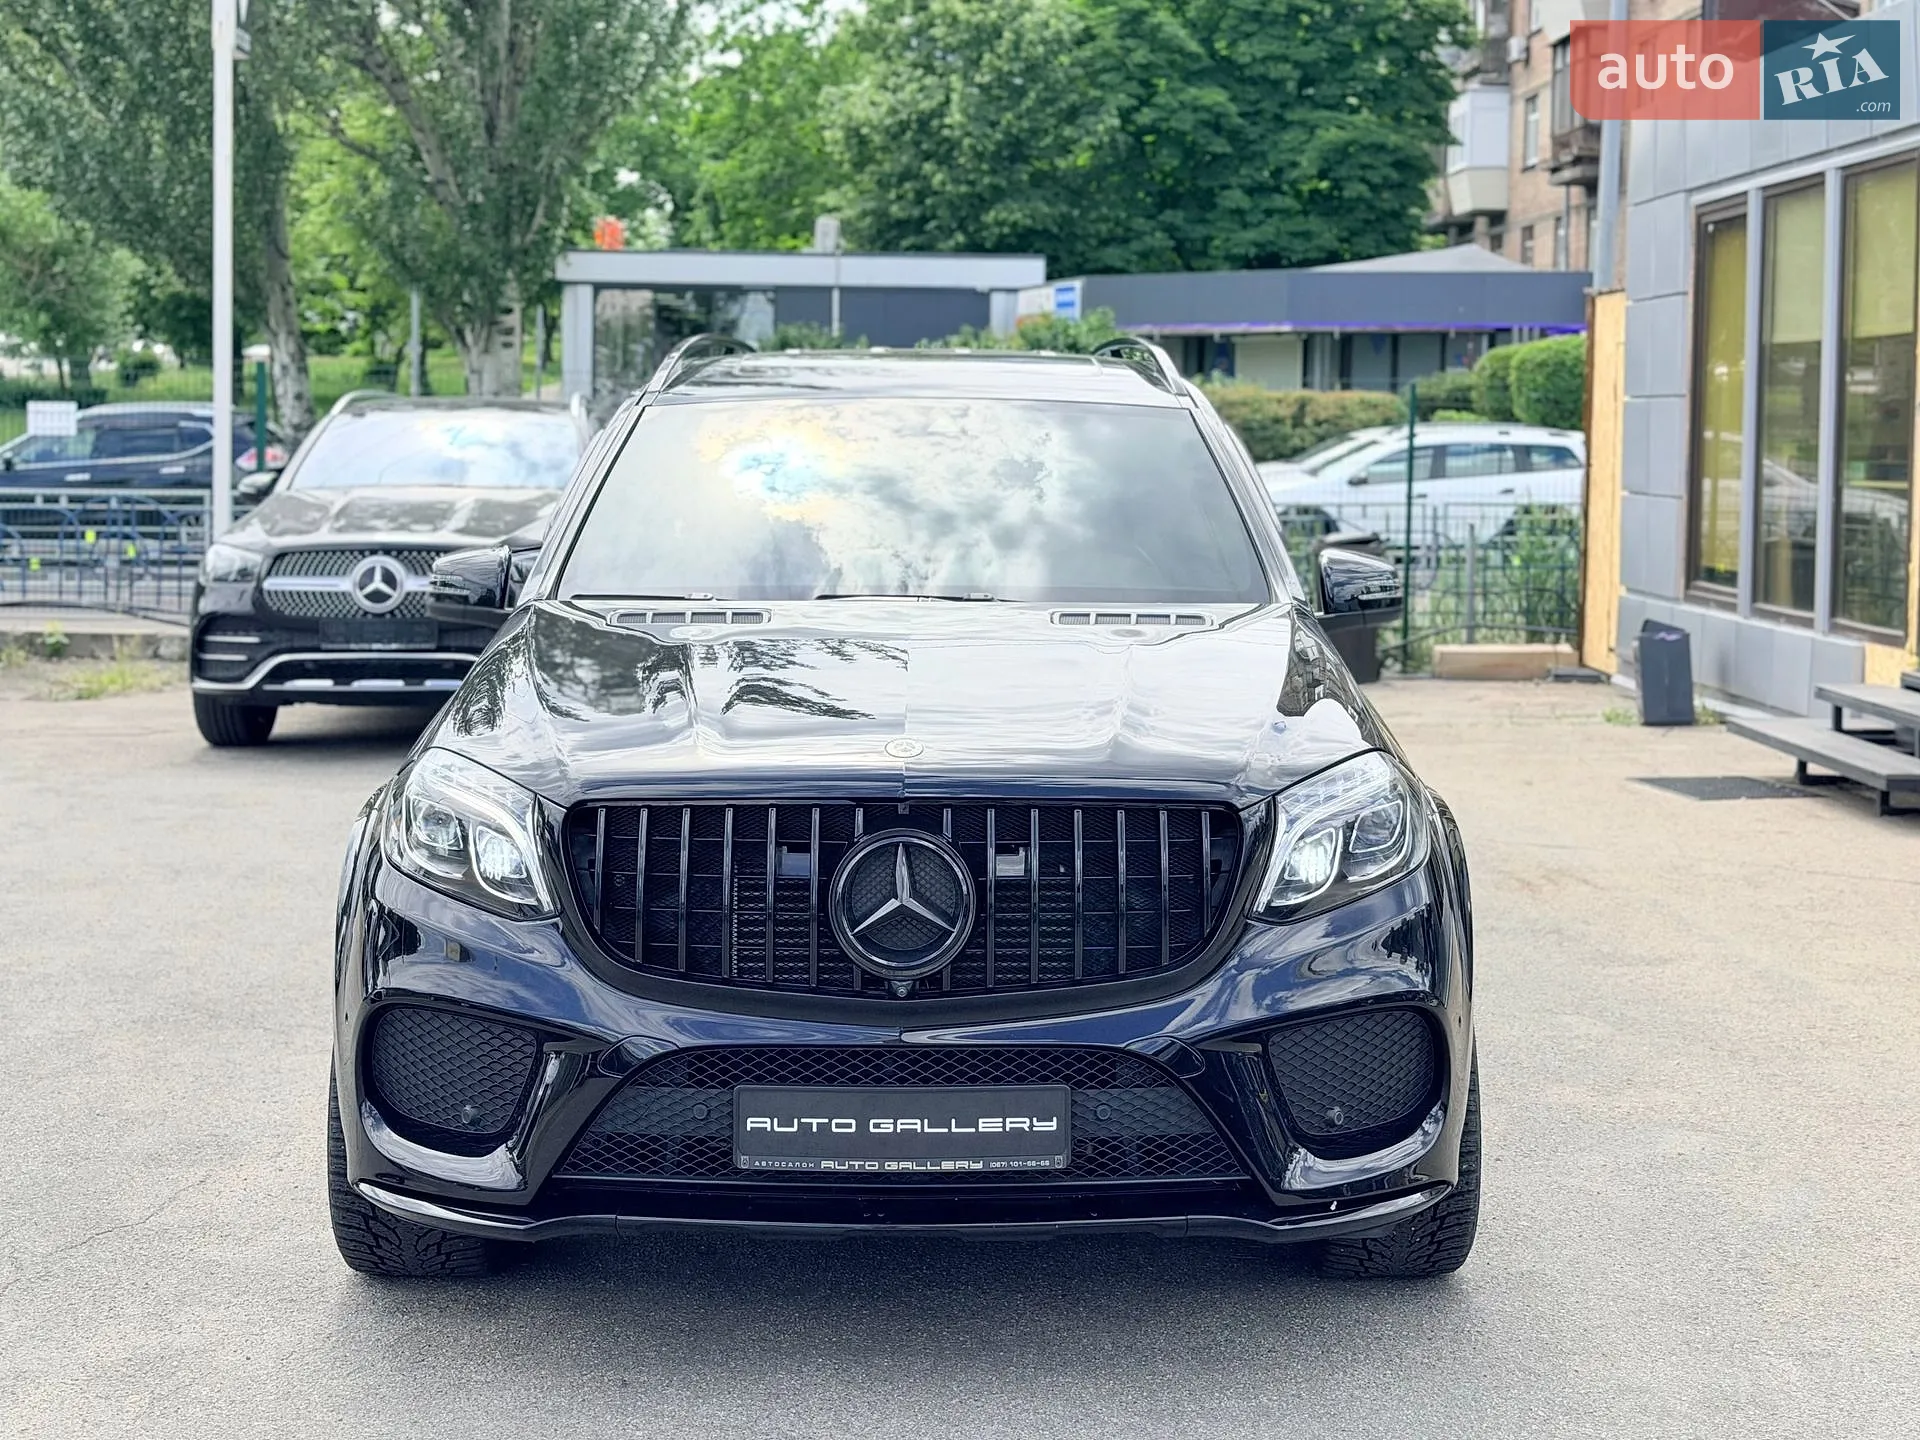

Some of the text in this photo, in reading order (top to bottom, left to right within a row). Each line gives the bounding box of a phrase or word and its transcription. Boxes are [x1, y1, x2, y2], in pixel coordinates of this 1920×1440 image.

[746, 1115, 1058, 1133] AUTO GALLERY
[820, 1160, 880, 1170] AUTO
[884, 1160, 983, 1170] GALLERY
